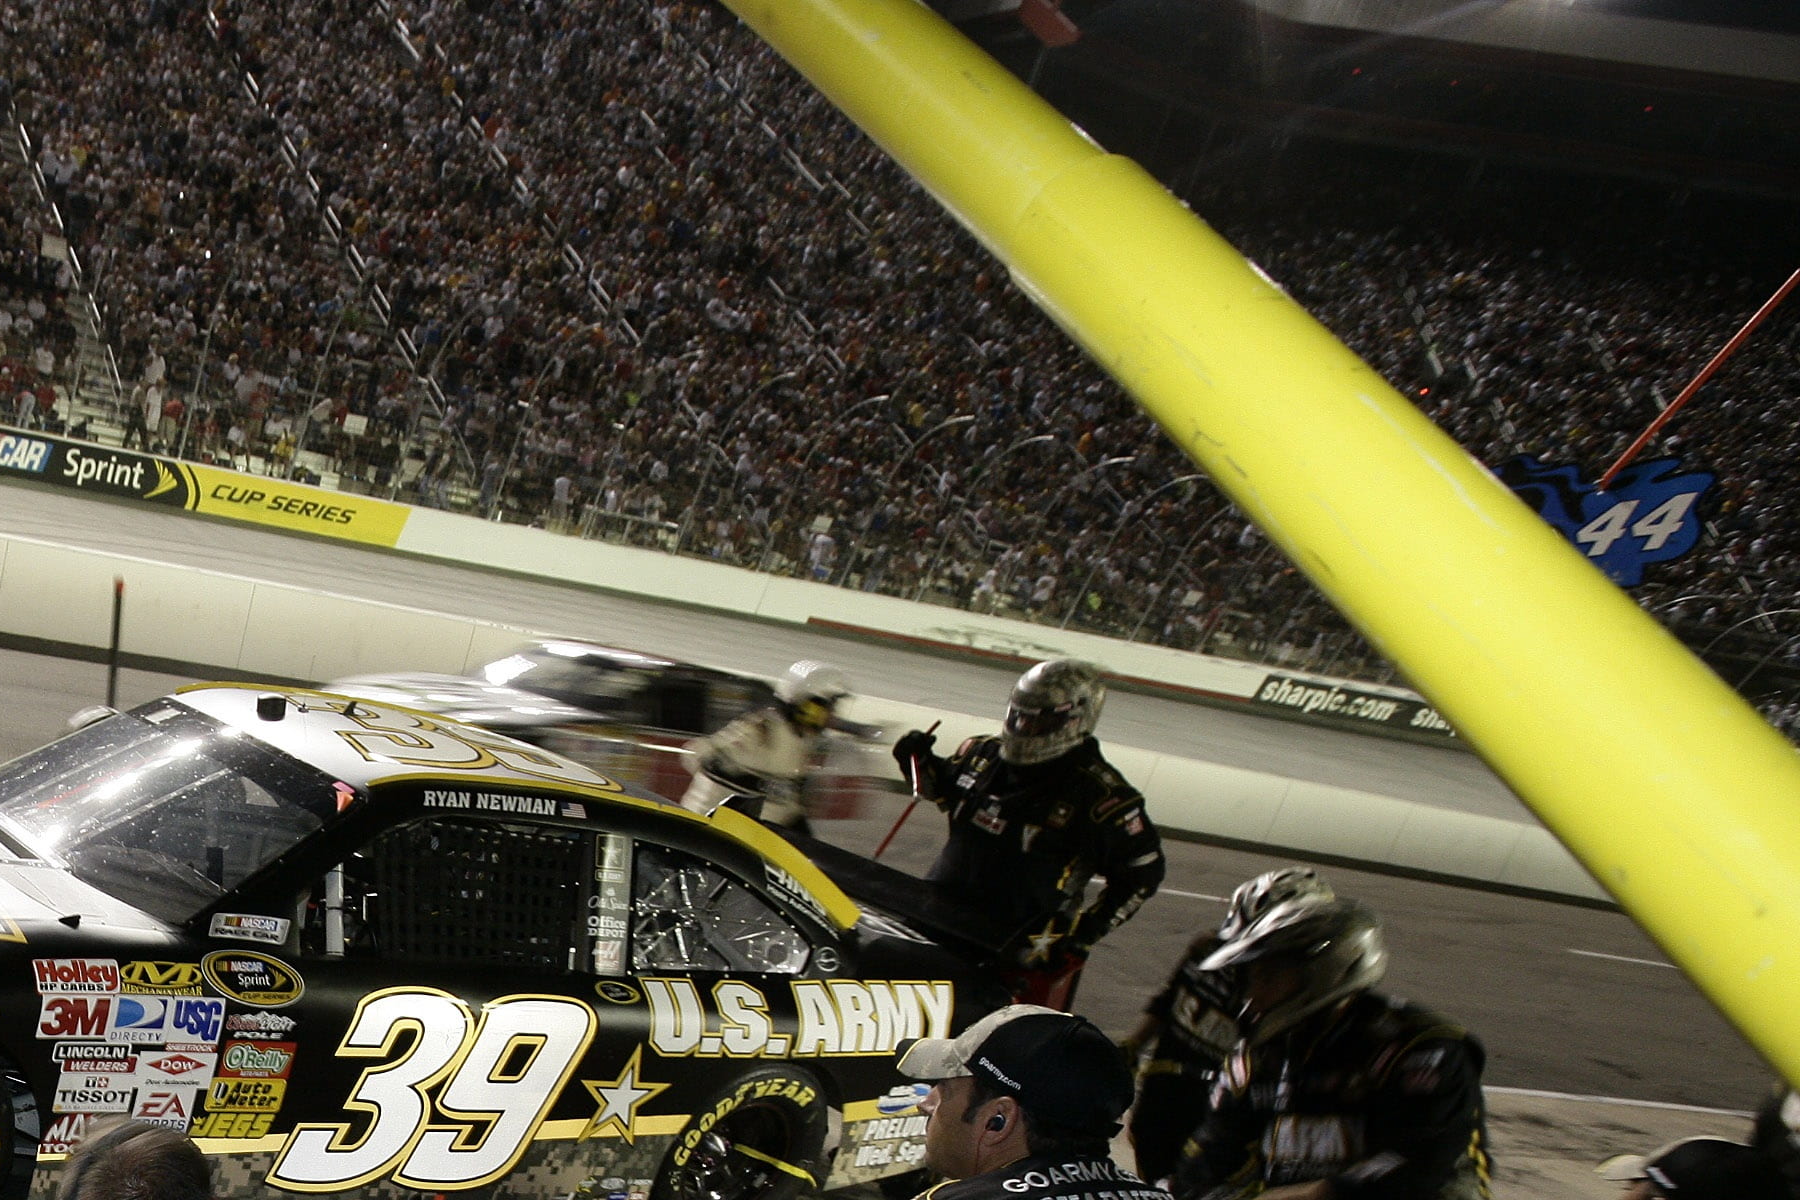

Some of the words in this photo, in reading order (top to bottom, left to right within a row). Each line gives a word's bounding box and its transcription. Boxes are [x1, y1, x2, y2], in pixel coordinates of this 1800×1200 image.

[62, 445, 145, 491] Sprint
[210, 483, 267, 511] CUP
[272, 490, 357, 526] SERIES
[1578, 491, 1698, 557] 44
[422, 790, 474, 808] RYAN
[476, 792, 557, 816] NEWMAN
[240, 916, 278, 931] NASCAR
[251, 930, 281, 942] CAR
[35, 959, 118, 992] Holley
[231, 960, 264, 973] NASCAR
[40, 982, 56, 991] HP
[61, 983, 104, 992] CARBS
[173, 985, 203, 997] WEAR
[237, 973, 271, 989] Sprint
[40, 997, 111, 1036] 3M
[173, 999, 223, 1042] USG
[639, 977, 788, 1059] U.S.
[791, 978, 954, 1058] ARMY
[110, 1031, 163, 1042] DIRECTV
[58, 1046, 126, 1059] LINCOLN
[160, 1059, 196, 1071] DOW
[225, 1044, 290, 1073] O'Reilly
[70, 1060, 130, 1072] WELDERS
[978, 1056, 1022, 1091] goarmy.com
[57, 1089, 131, 1104] TISSOT
[227, 1094, 278, 1107] Meter
[232, 1082, 272, 1094] Auto
[265, 986, 599, 1192] 39
[136, 1092, 186, 1118] EA
[188, 1113, 276, 1138] JEGS
[674, 1078, 816, 1167] GOODYEAR
